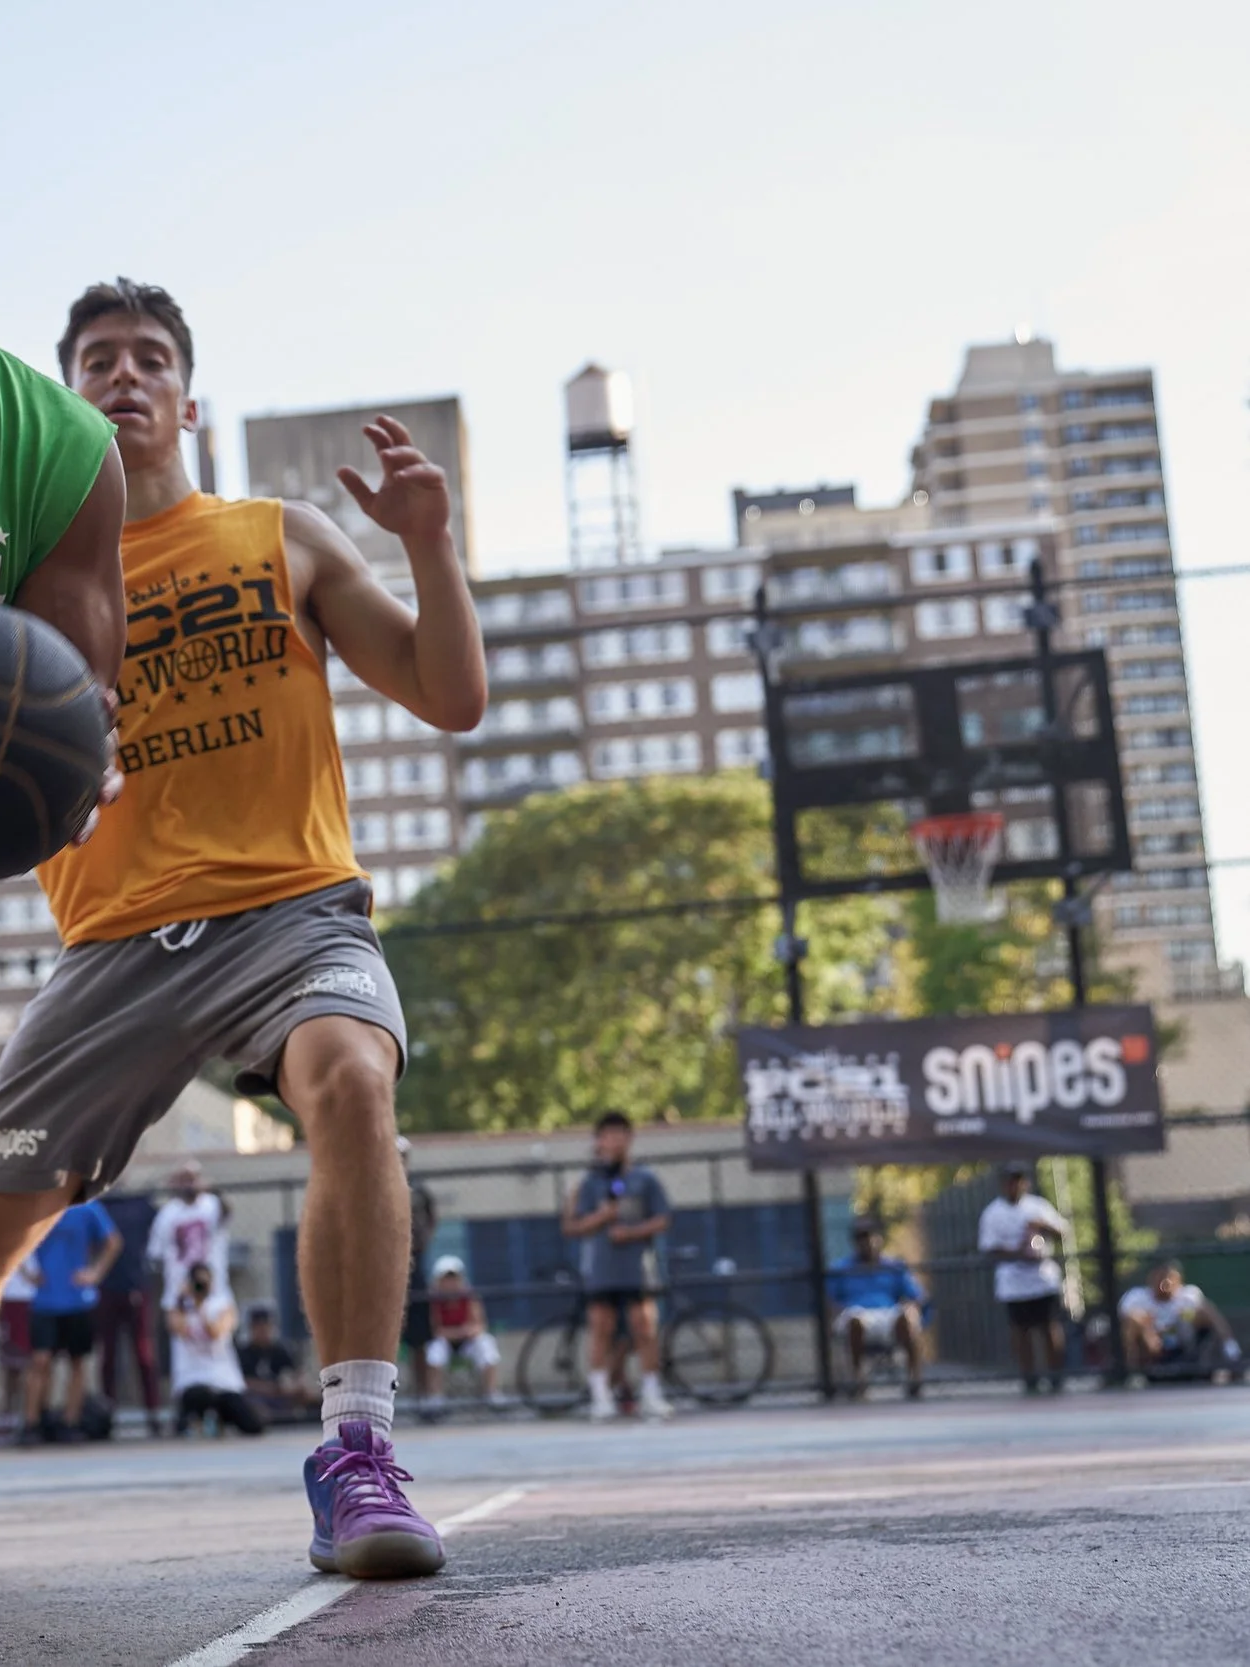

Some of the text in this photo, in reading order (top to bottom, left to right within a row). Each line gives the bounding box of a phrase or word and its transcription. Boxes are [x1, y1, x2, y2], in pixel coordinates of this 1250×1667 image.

[124, 578, 291, 659] C21
[117, 708, 265, 775] BERLIN
[922, 1036, 1128, 1125] snipes
